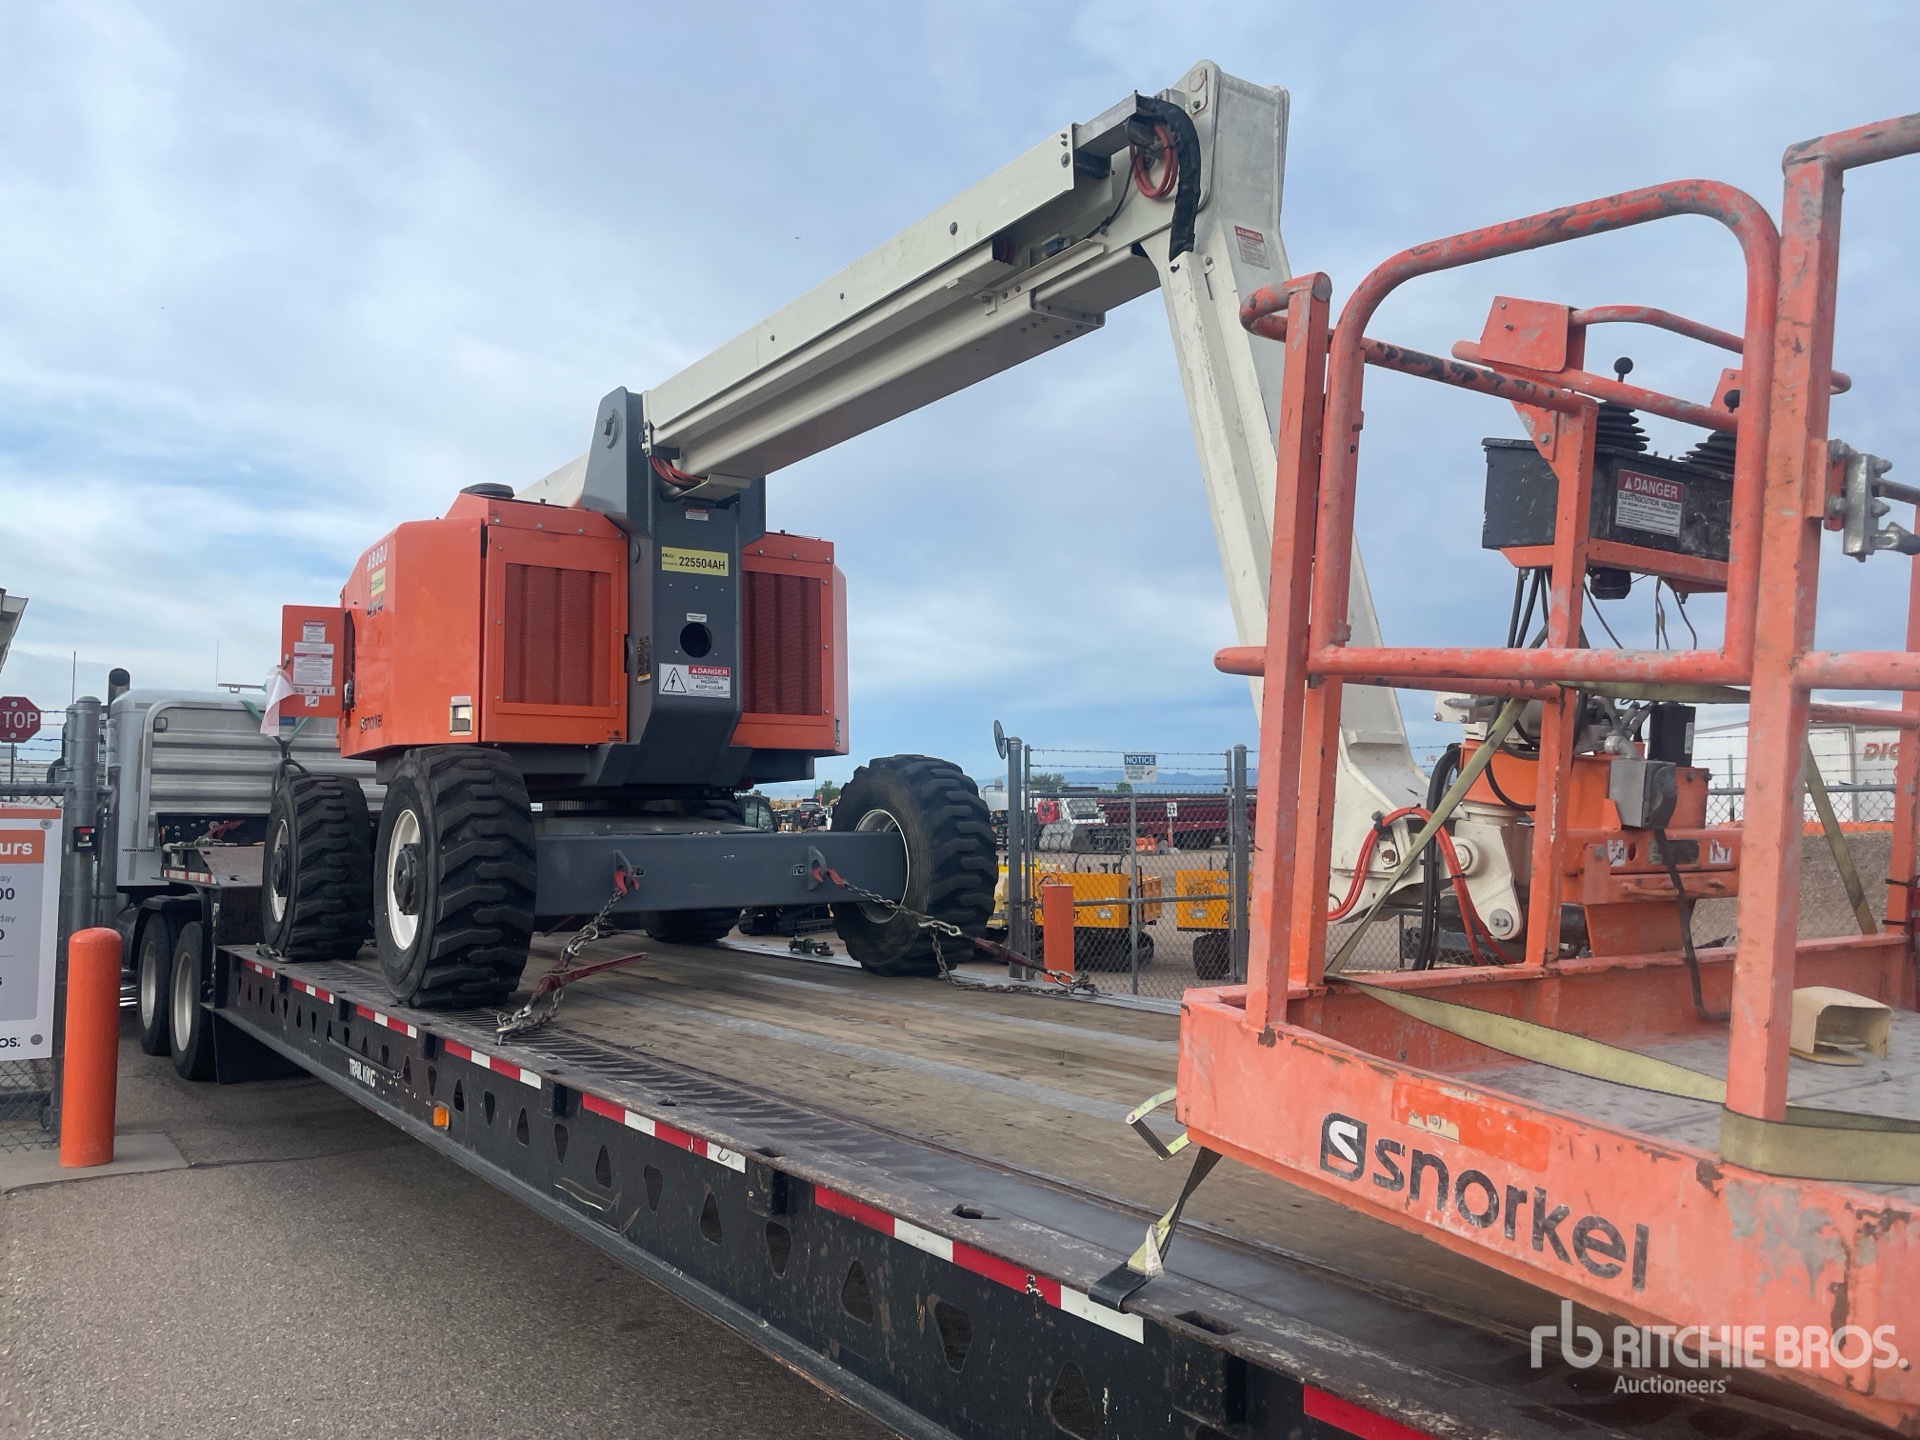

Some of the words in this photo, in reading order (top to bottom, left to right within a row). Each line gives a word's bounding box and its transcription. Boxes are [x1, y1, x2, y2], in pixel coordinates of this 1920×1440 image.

[1634, 478, 1678, 499] DANGER
[679, 556, 725, 570] 225504AH
[698, 668, 728, 676] DANGER
[0, 711, 38, 729] TOP
[1126, 756, 1154, 765] NOTICE
[1372, 1138, 1649, 1292] snorkel
